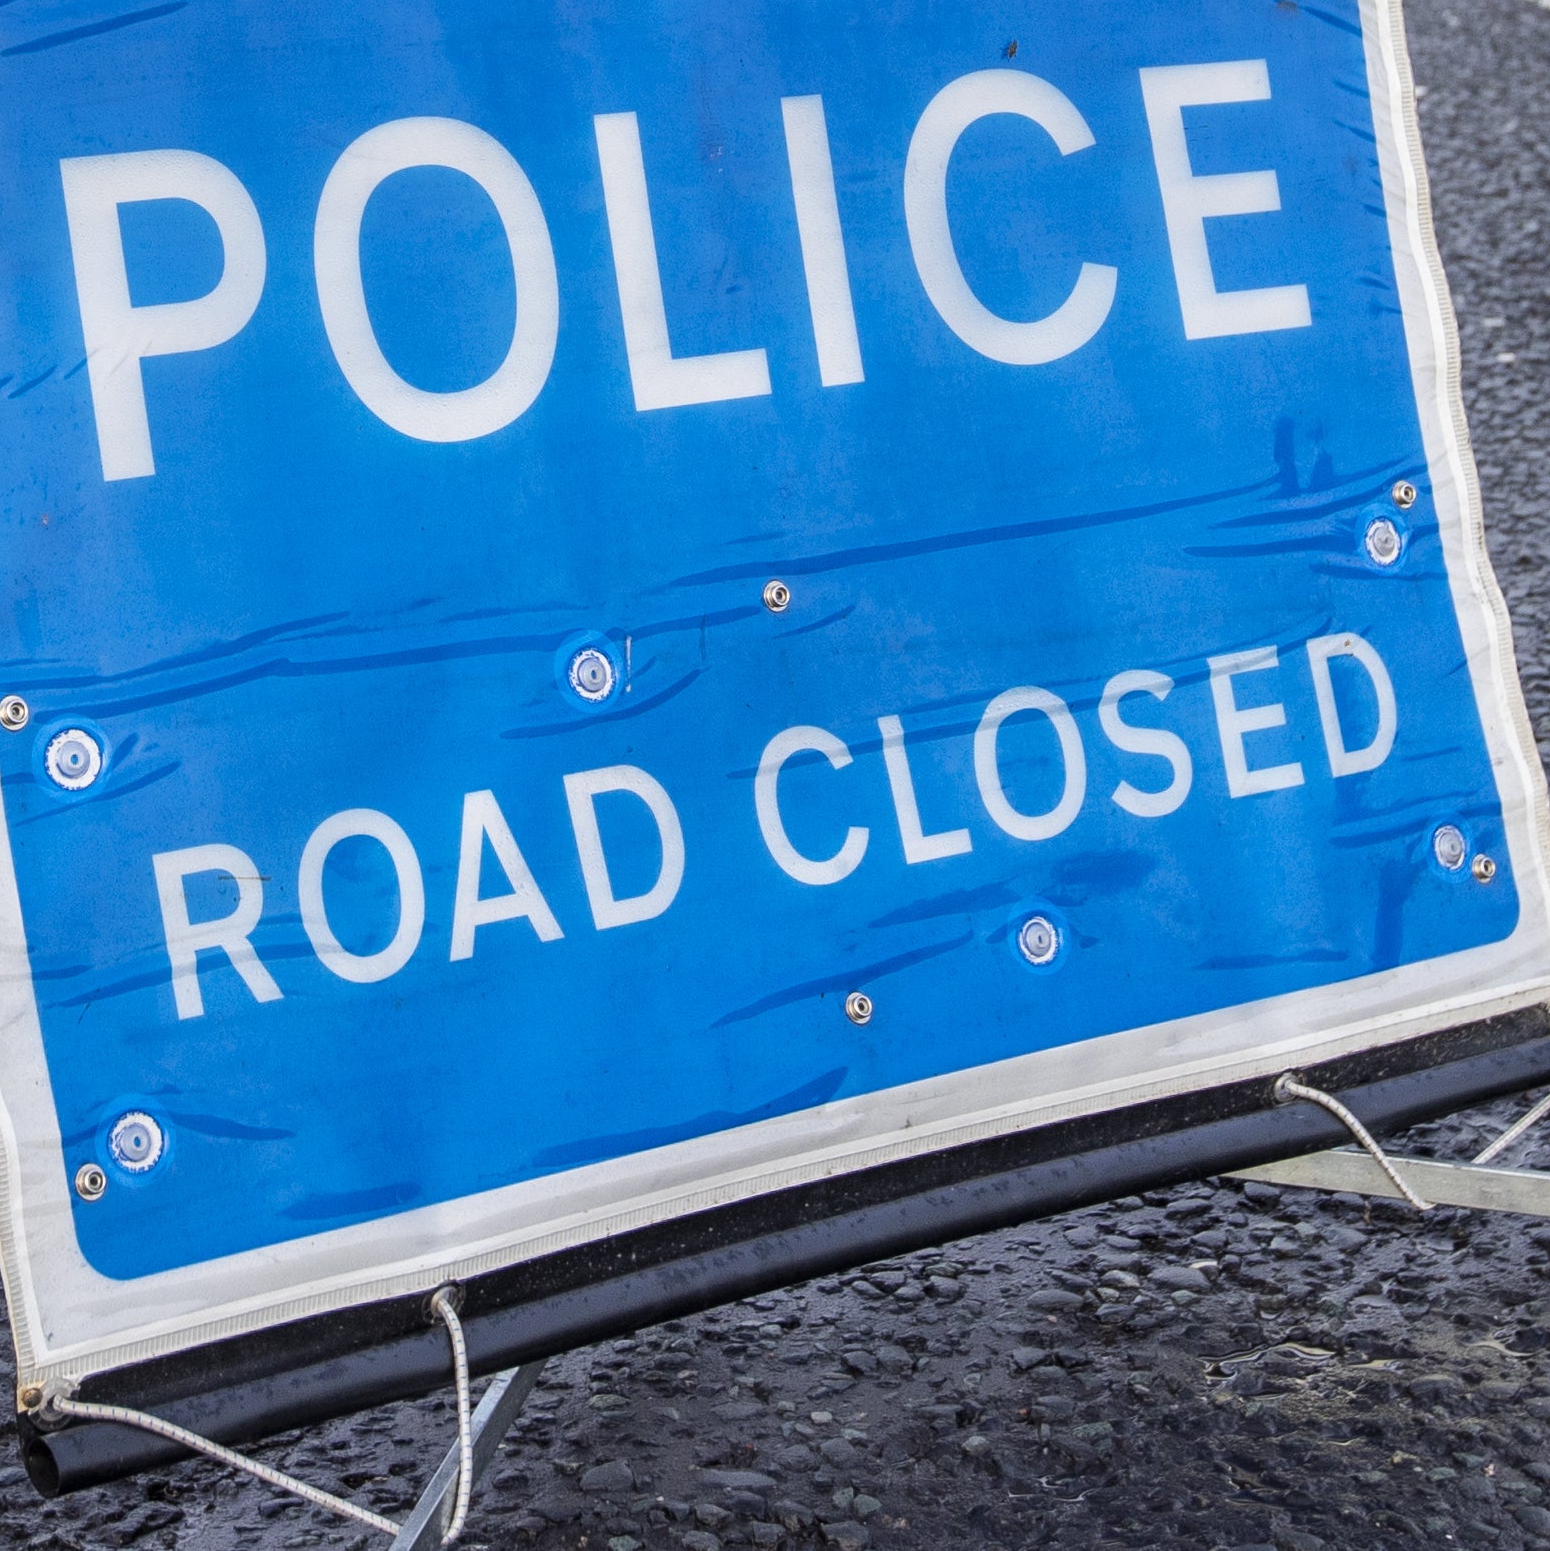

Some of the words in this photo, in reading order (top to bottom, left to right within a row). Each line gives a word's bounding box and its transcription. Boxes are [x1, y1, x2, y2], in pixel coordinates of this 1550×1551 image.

[59, 58, 1312, 483] POLICE
[151, 763, 686, 1021] ROAD
[754, 631, 1398, 887] CLOSED
